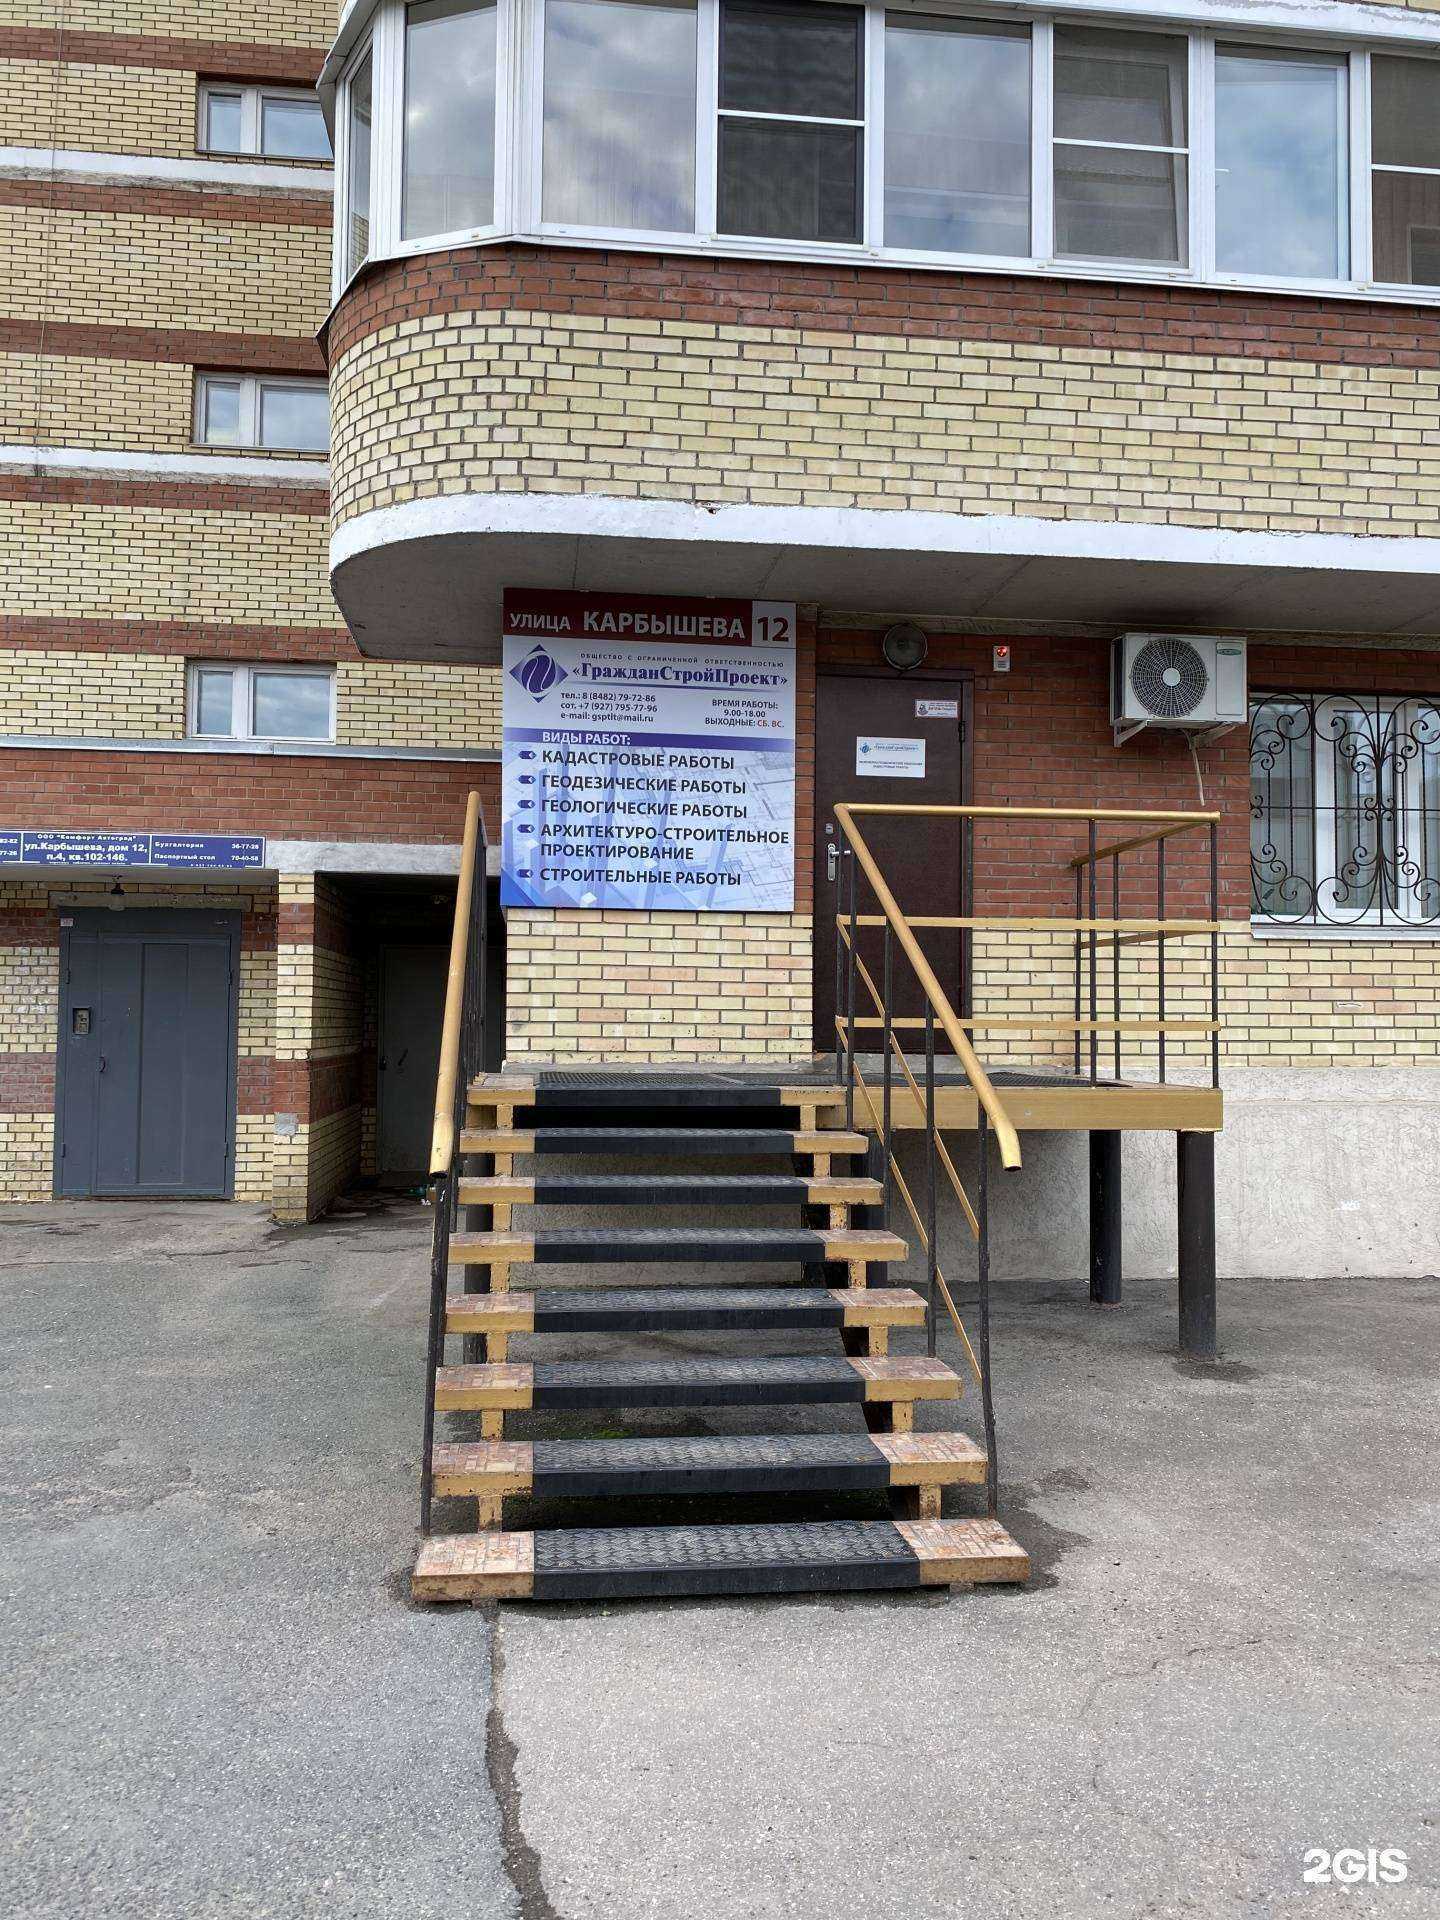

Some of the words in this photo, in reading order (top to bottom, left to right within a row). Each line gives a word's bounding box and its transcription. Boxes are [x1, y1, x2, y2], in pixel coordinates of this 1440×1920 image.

[510, 612, 571, 632] УЛИЦА
[583, 611, 745, 639] КАРБЫШЕВА
[757, 617, 790, 643] 12
[637, 655, 698, 663] ОГРАНИЧЕННОЙ
[704, 658, 784, 668] ОТВЕТСТВЕННОСТЬЮ
[572, 662, 788, 686] «ГражданСтройПроект»
[560, 692, 580, 700] тел.:
[589, 692, 616, 702] (8482)
[618, 693, 656, 702] 79-72-86
[712, 699, 740, 708] ВРЕМЯ
[741, 701, 779, 709] РАБОТЫ:
[579, 702, 590, 710] +7
[591, 702, 613, 711] (927)
[615, 703, 658, 713] 795-77-96
[723, 709, 766, 718] 9.00-18.00
[705, 717, 756, 727] ВЫХОДНЫЕ:
[757, 720, 770, 728] СБ.
[771, 720, 785, 728] ВС.
[542, 731, 582, 745] ВИДЫ
[585, 733, 631, 746] РАБОТ:
[542, 750, 665, 768] КАДАСТРОВЫЕ
[669, 755, 735, 770] РАБОТЫ
[542, 775, 677, 792] ГЕОДЕЗИЧЕСКИЕ
[681, 779, 746, 794] РАБОТЫ
[541, 799, 678, 816] ГЕОЛОГИЧЕСКИЕ
[682, 804, 747, 819] РАБОТЫ
[541, 824, 789, 844] АРХИТЕКТУРО-СТРОИТЕЛЬНОЕ
[25, 841, 106, 853] ул.Карбышева,
[108, 844, 129, 853] дом
[132, 843, 148, 854] 12,
[541, 843, 694, 860] ПРОЕКТИРОВАНИЕ
[540, 868, 672, 883] СТРОИТЕЛЬНЫЕ
[676, 871, 741, 886] РАБОТЫ
